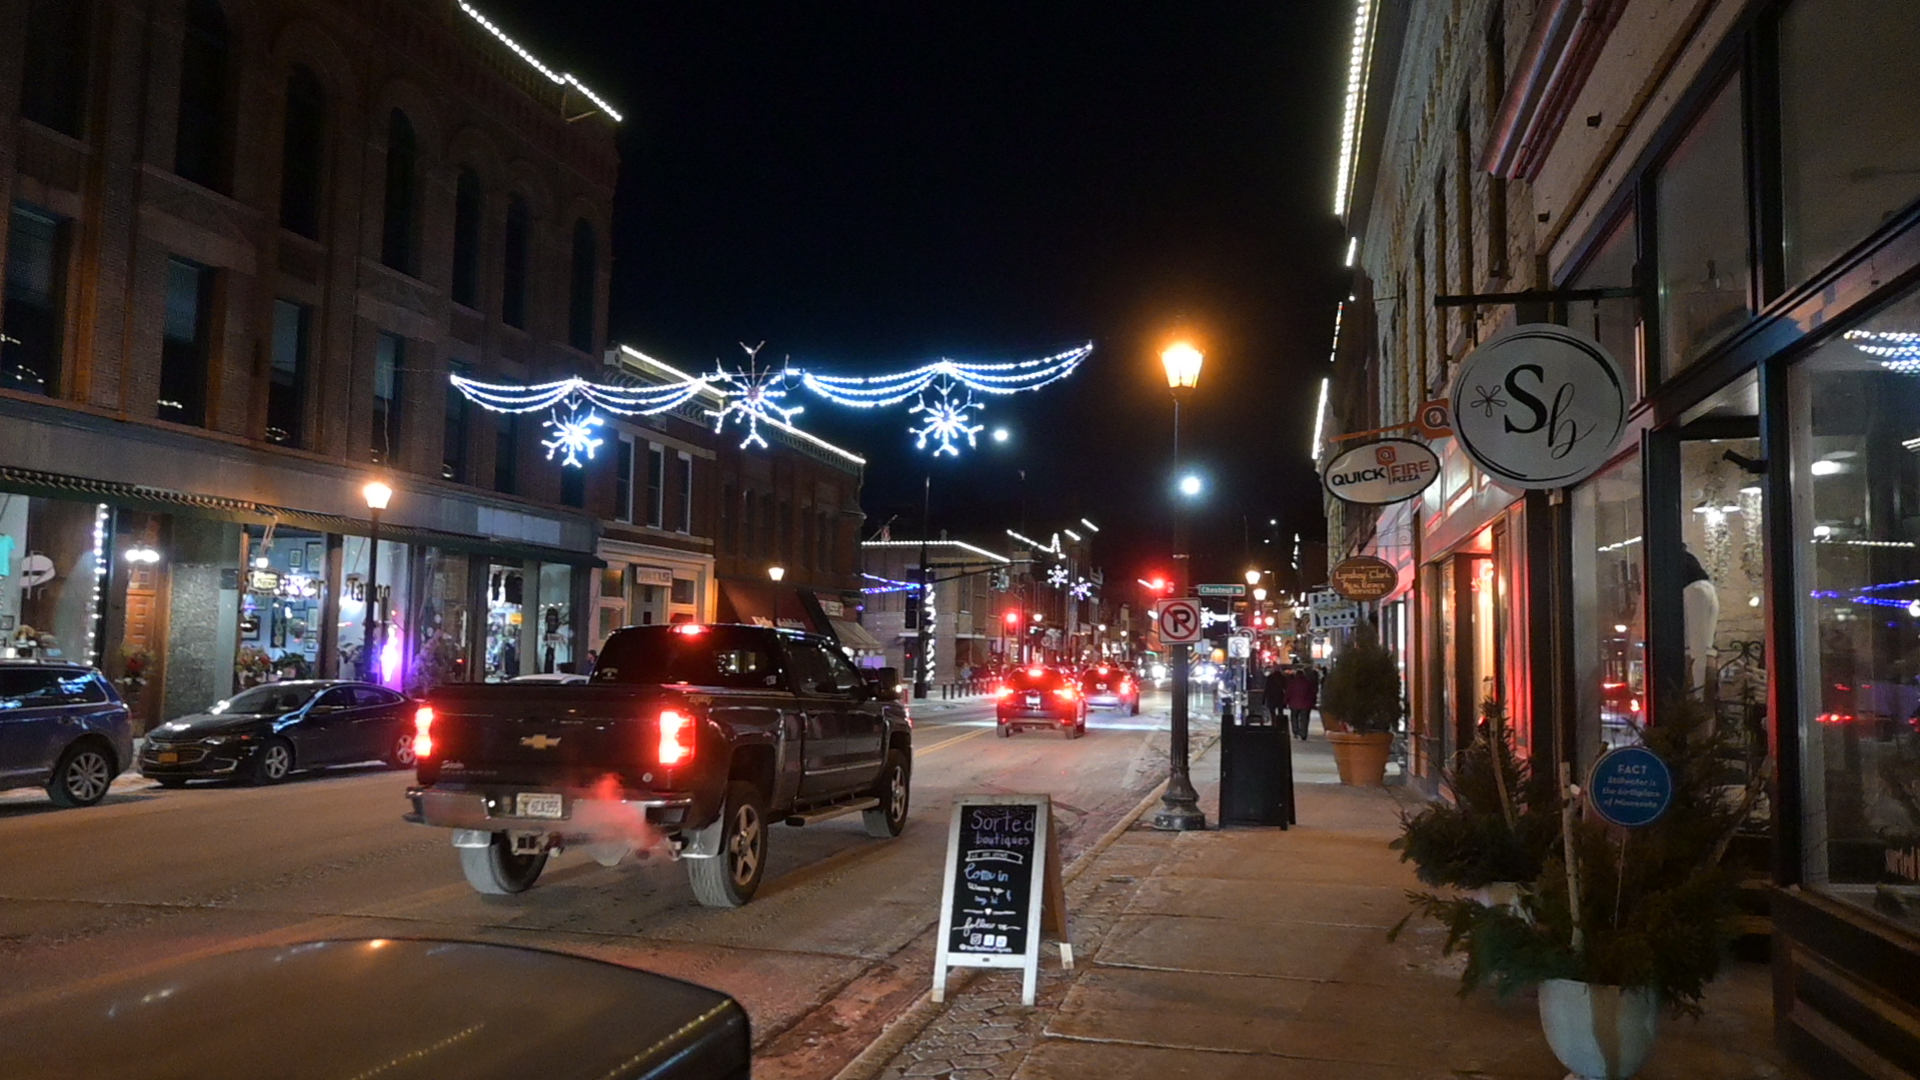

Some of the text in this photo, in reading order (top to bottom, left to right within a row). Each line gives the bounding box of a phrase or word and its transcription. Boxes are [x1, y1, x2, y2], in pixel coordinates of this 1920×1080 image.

[1331, 460, 1431, 487] QUICK FIRE
[1392, 474, 1421, 484] PIZZA
[1202, 586, 1233, 594] Chestnut
[1617, 764, 1647, 775] FACT
[971, 810, 1034, 833] Sorted
[975, 831, 1030, 848] boutiques
